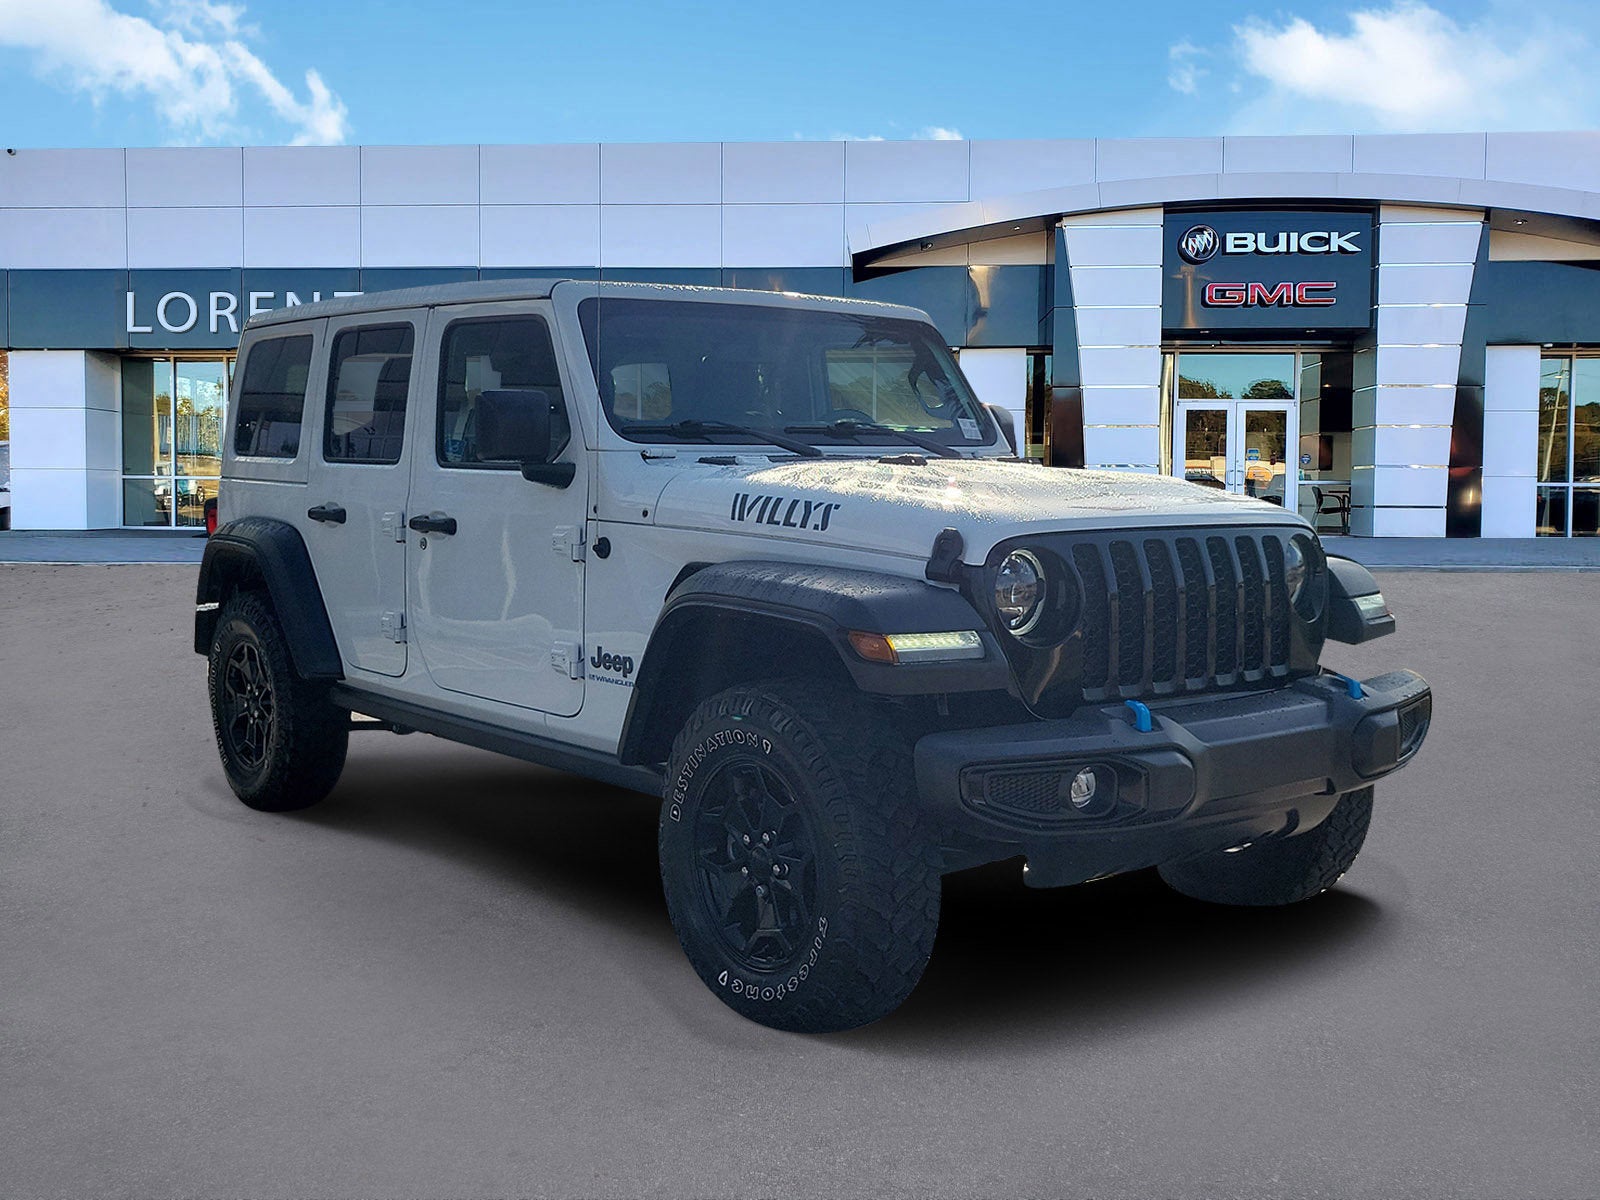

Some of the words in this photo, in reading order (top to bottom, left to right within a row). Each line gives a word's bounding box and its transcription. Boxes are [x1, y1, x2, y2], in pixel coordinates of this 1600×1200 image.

[1225, 231, 1362, 253] BUICK
[126, 291, 364, 333] LORE
[1205, 281, 1337, 306] GMC
[730, 492, 841, 532] WILLYS
[591, 645, 634, 679] Jeep
[670, 729, 759, 822] DESTINATION
